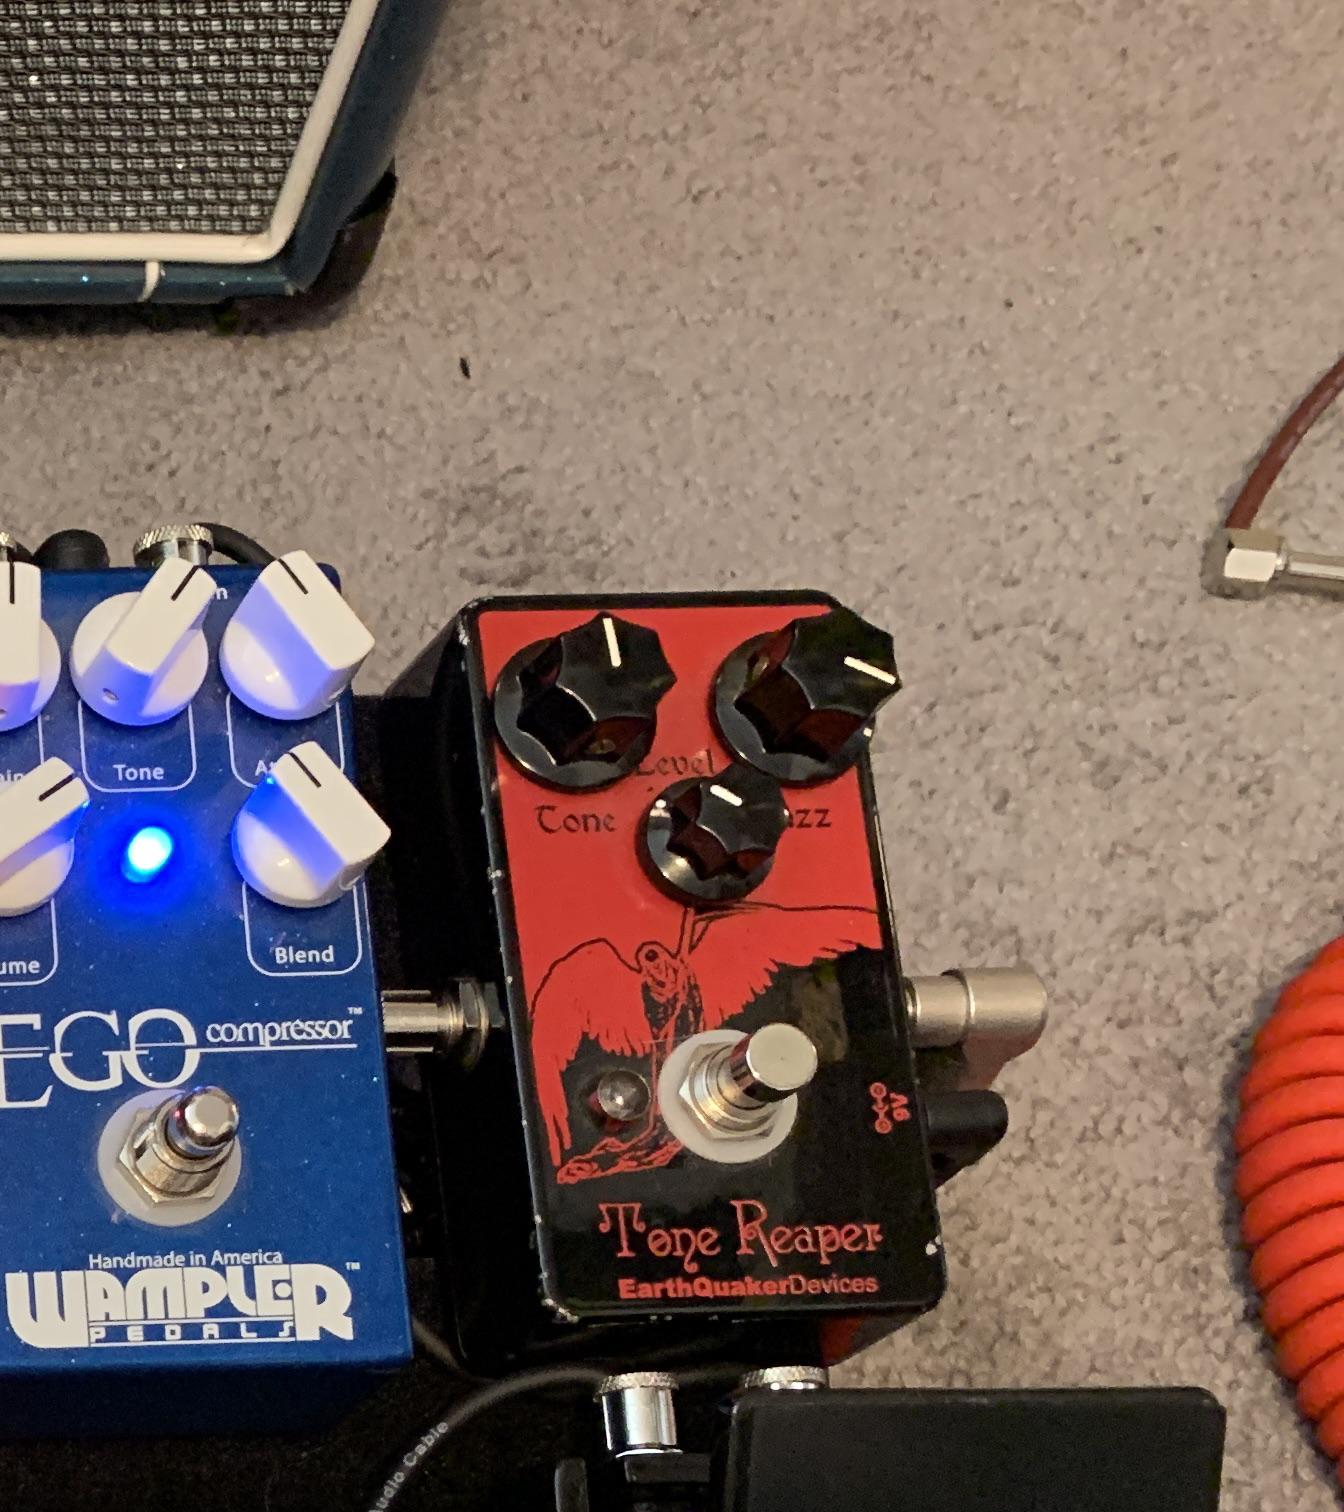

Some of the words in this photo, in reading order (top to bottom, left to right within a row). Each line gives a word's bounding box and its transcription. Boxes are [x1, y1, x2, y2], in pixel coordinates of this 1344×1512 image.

[113, 764, 164, 782] Tone
[275, 946, 334, 964] Blend
[206, 1017, 353, 1046] compressor
[598, 1202, 721, 1273] Tone
[731, 1200, 883, 1267] Reaper
[89, 1252, 185, 1269] Handmade
[189, 1251, 206, 1266] in
[211, 1249, 283, 1265] America
[5, 1263, 354, 1348] WAMPLER
[403, 1421, 449, 1467] Cable
